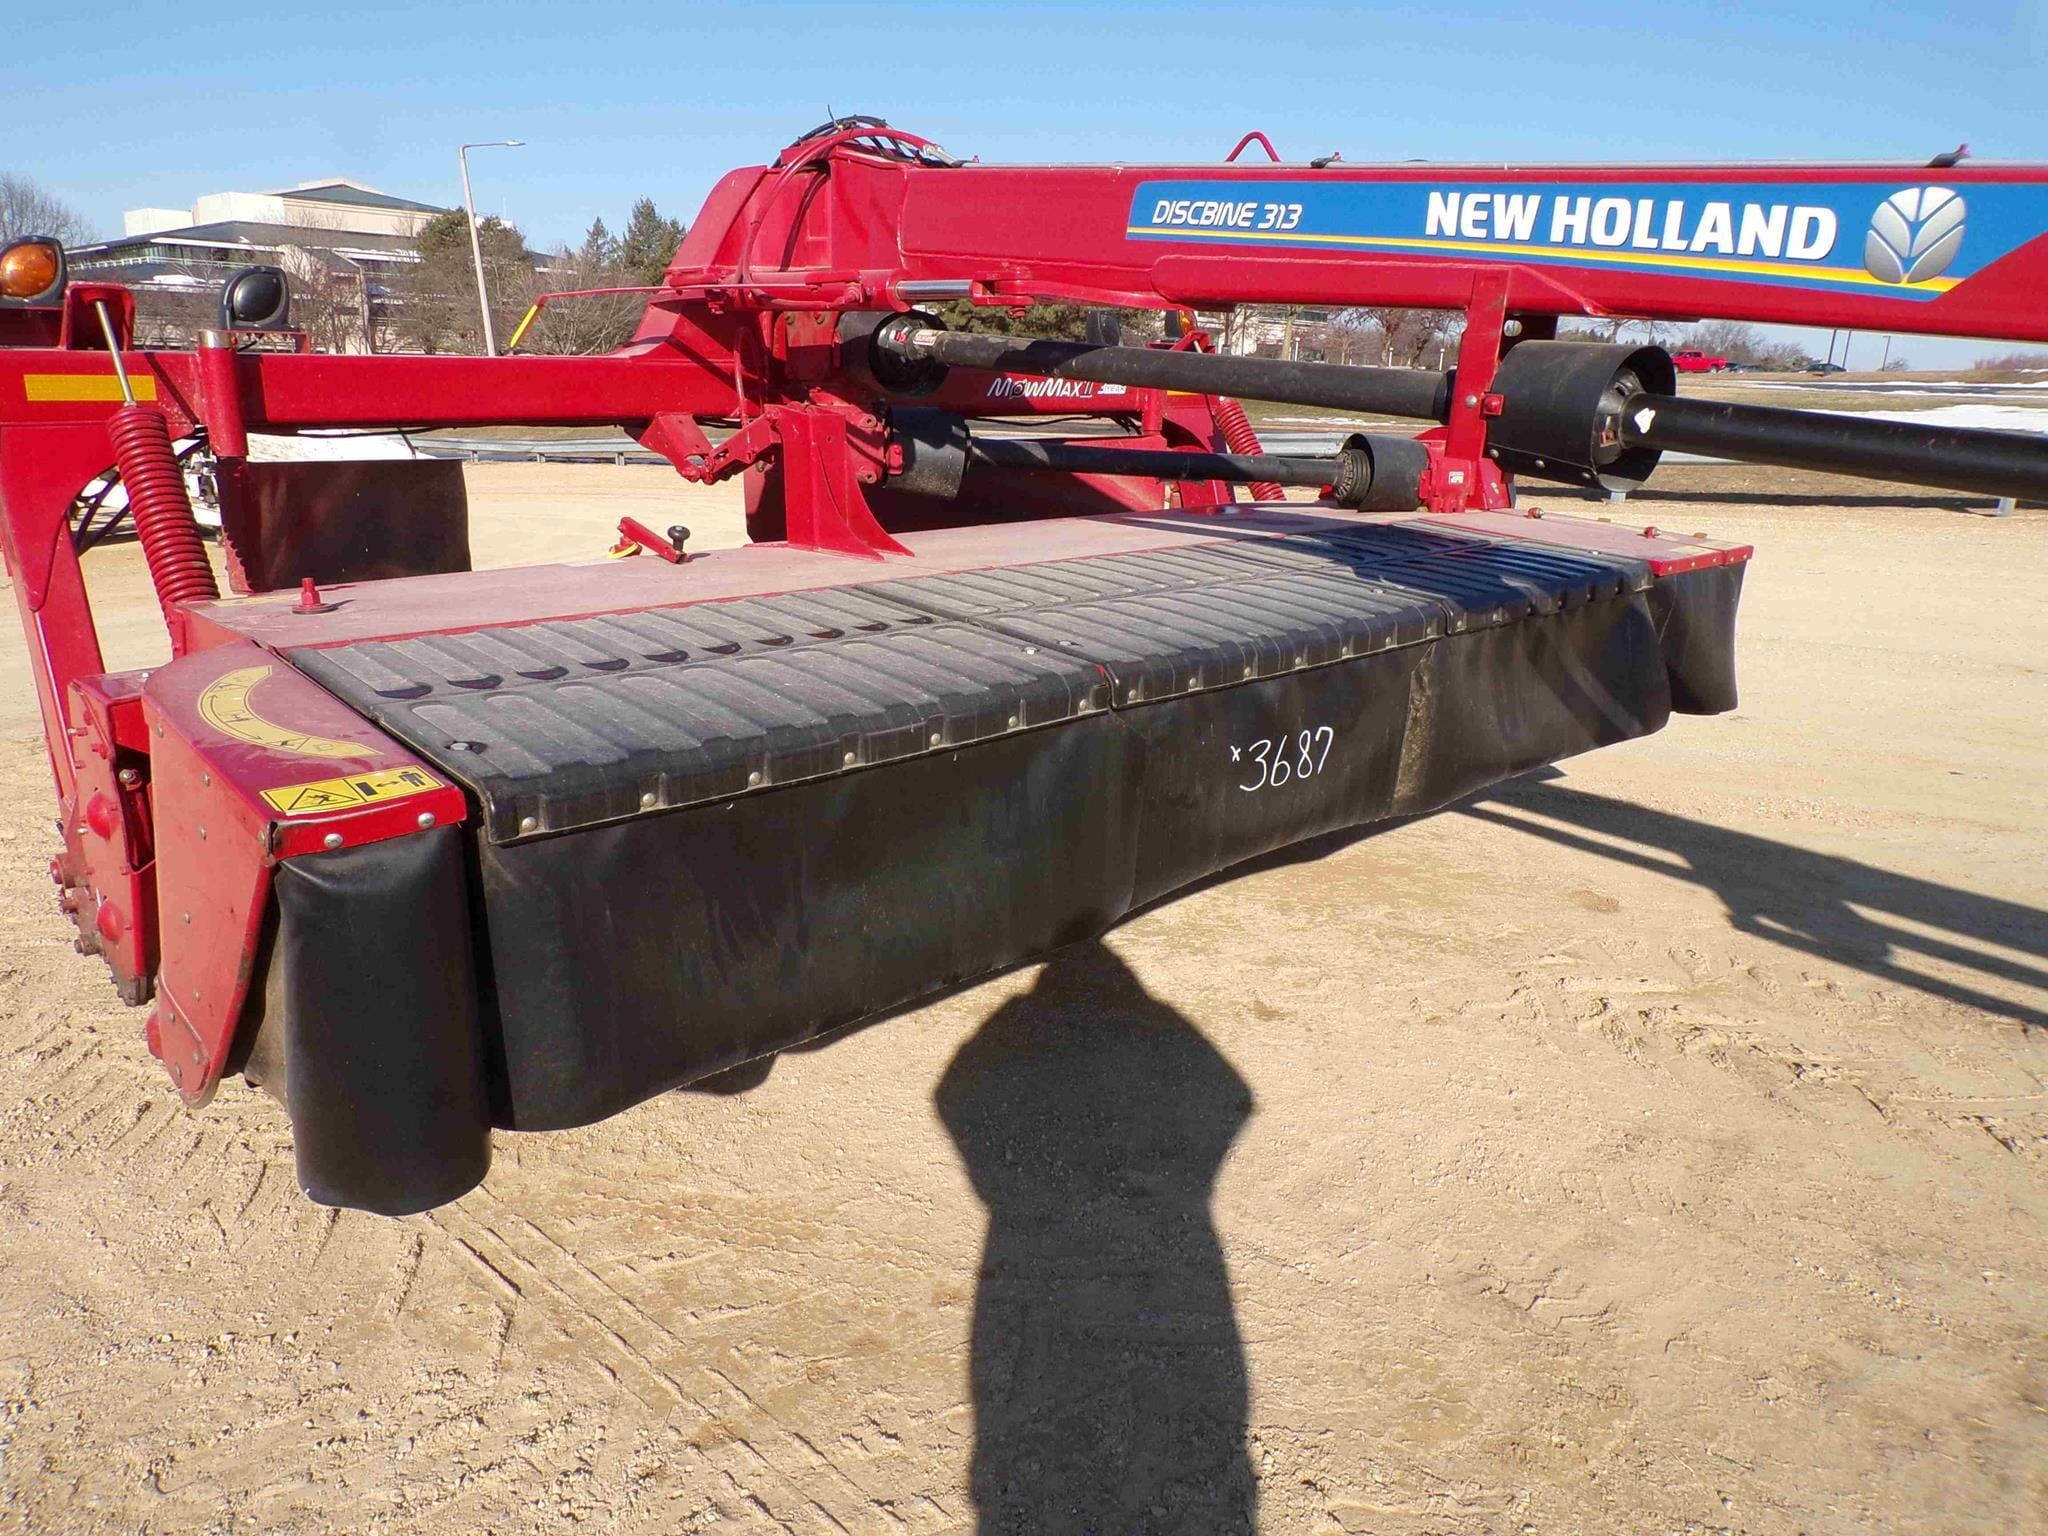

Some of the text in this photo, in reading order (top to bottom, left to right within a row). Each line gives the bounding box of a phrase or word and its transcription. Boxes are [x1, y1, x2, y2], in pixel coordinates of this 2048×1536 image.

[1152, 200, 1303, 230] DISCBINE 313
[1425, 191, 1838, 260] NEW HOLLAND
